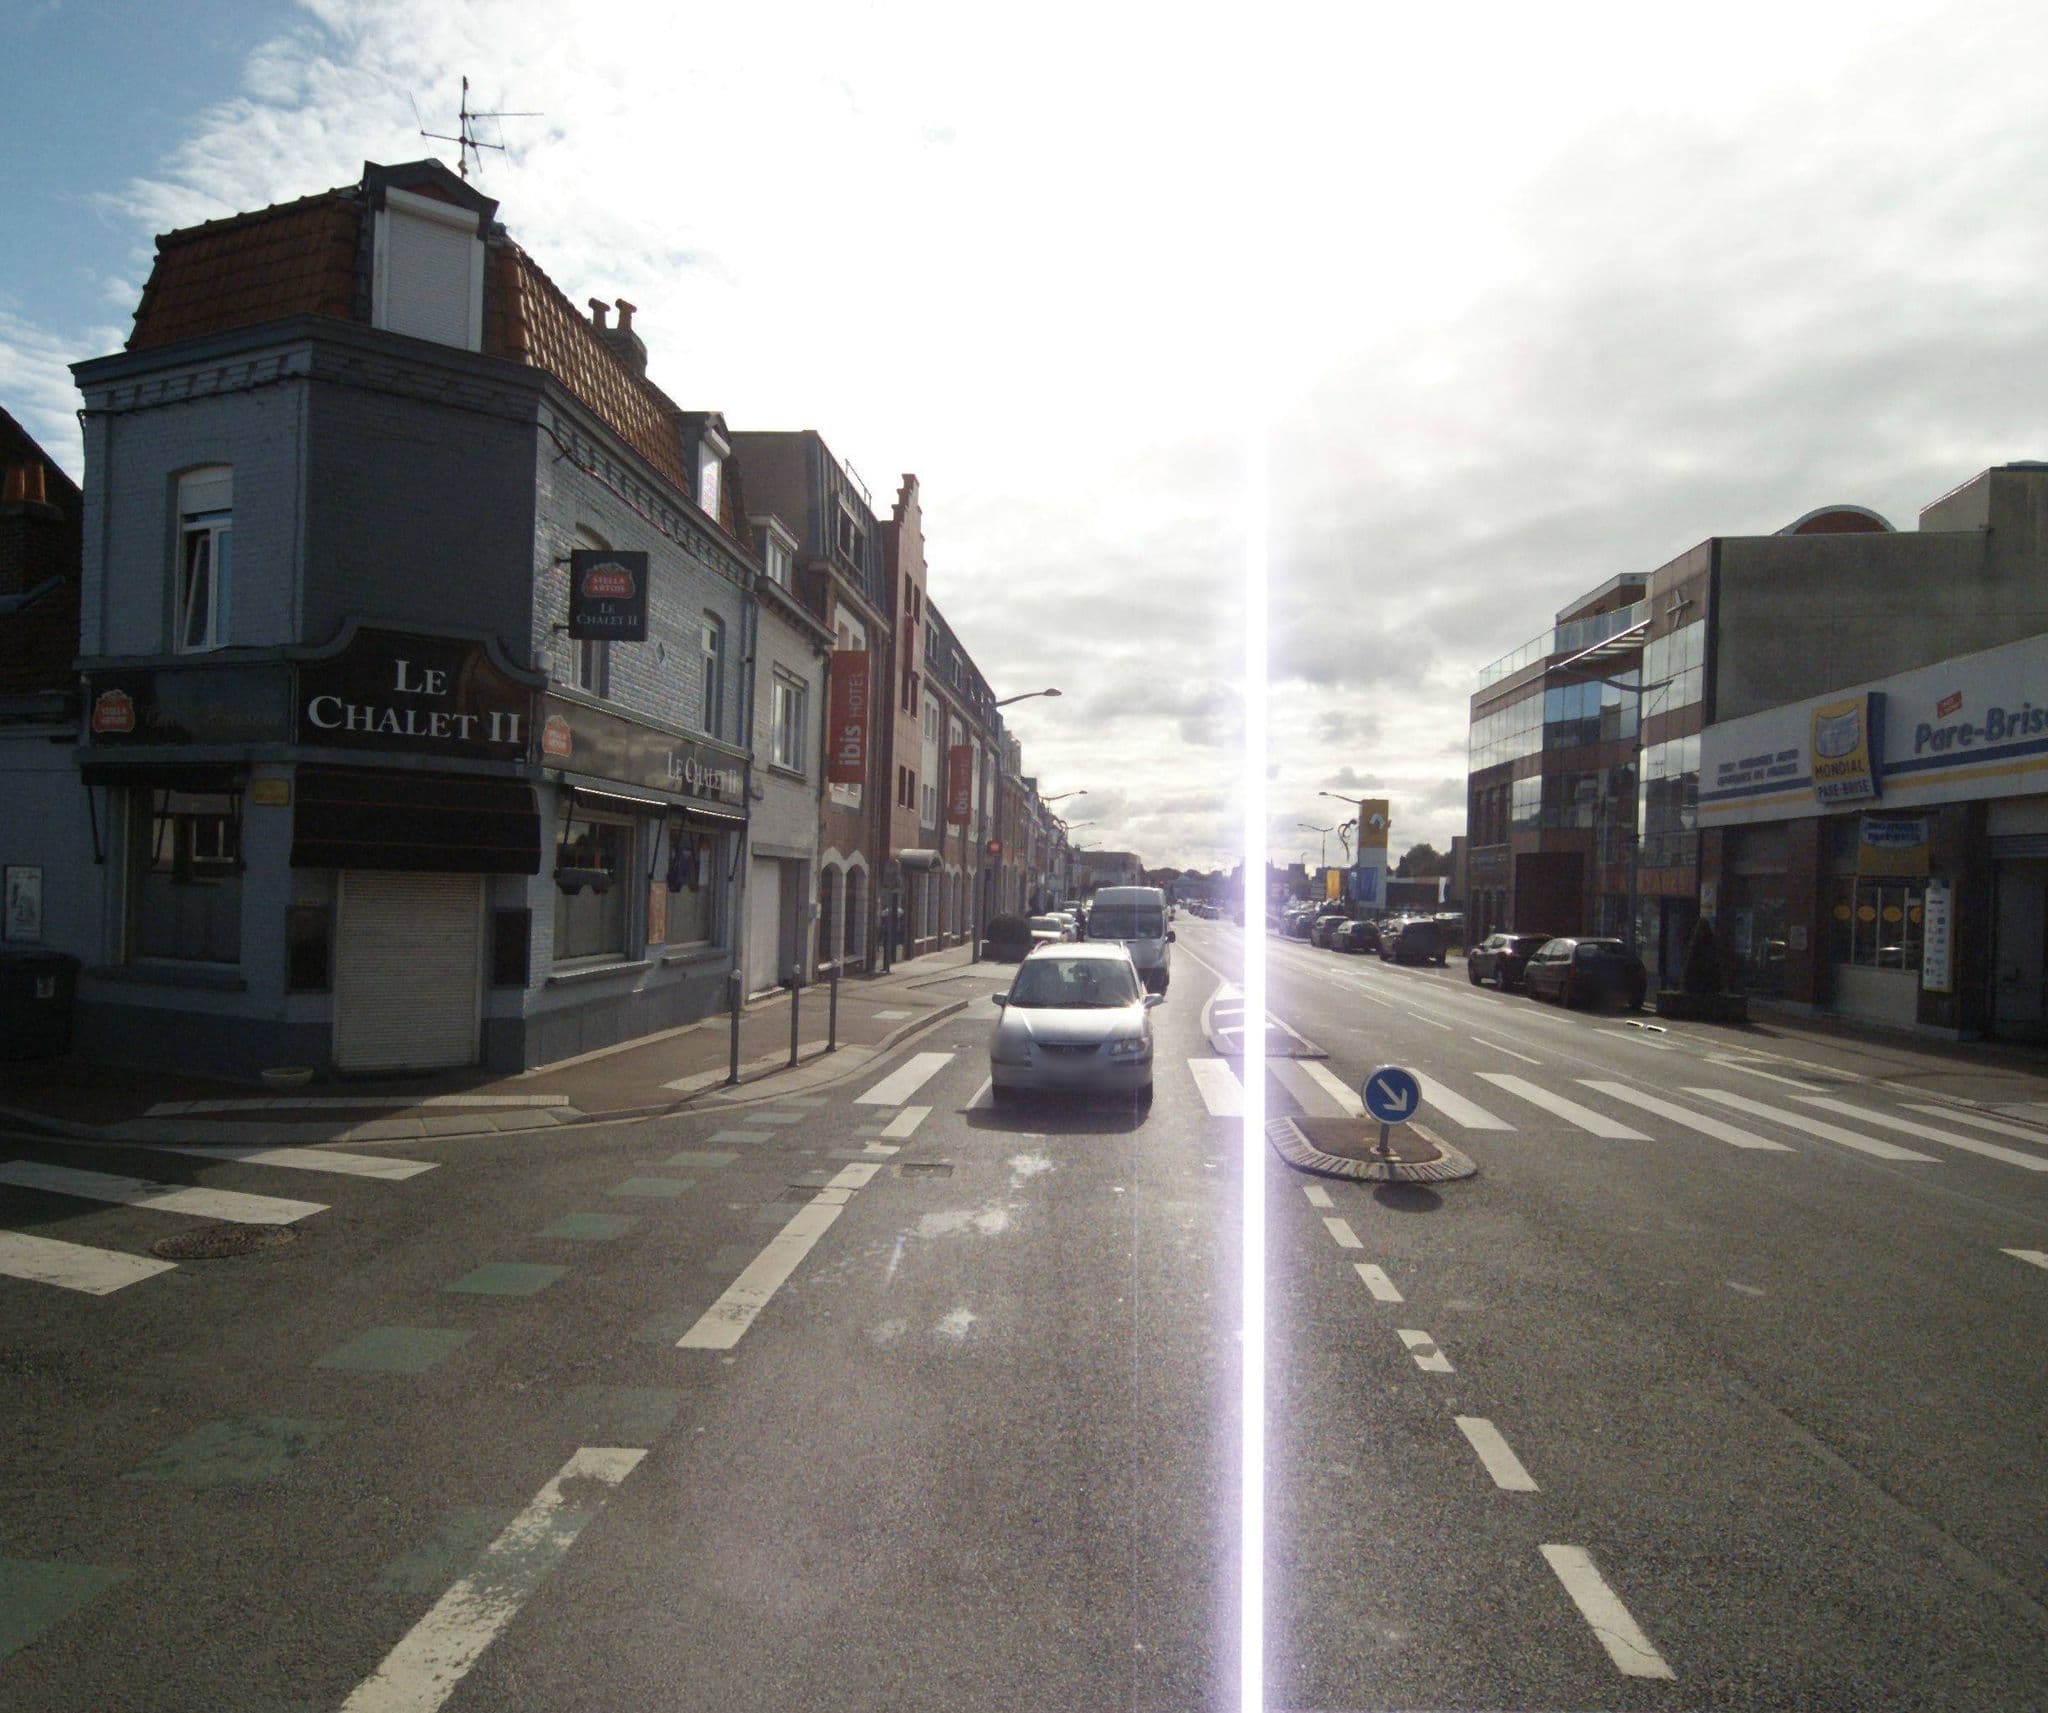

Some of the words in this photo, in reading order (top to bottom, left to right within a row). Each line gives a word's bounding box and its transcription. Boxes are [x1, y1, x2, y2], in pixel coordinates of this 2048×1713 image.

[393, 659, 448, 696] LE
[308, 695, 479, 741] CHALET
[488, 711, 521, 744] II
[839, 725, 862, 766] ibis
[1814, 759, 1865, 778] MONDIAL
[953, 789, 969, 815] ibis
